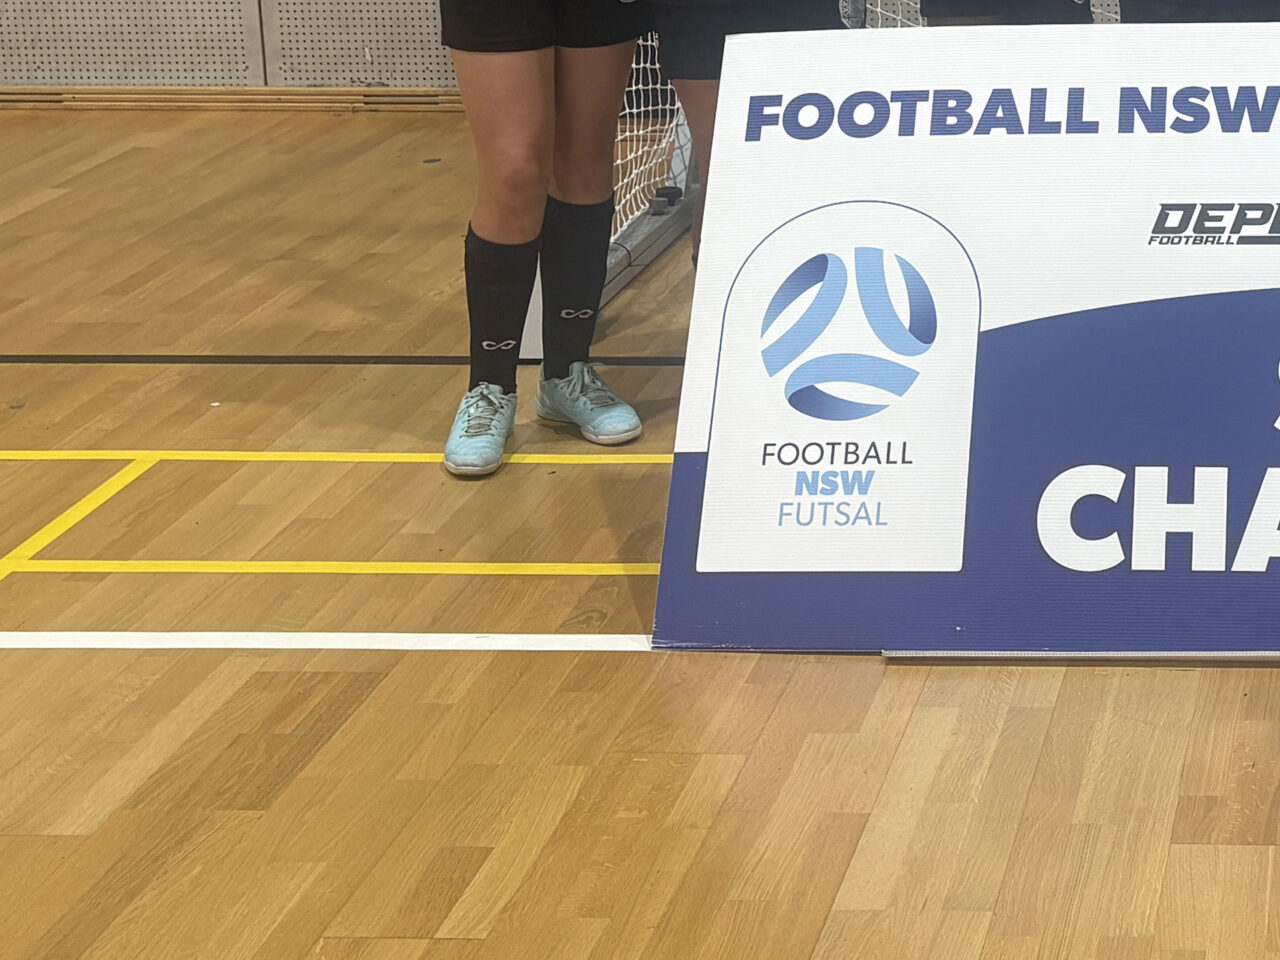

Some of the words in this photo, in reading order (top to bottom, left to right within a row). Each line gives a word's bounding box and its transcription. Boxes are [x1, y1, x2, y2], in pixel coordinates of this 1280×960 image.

[745, 88, 1100, 141] FOOTBALL
[1148, 235, 1235, 245] FOOTBALL
[762, 441, 913, 466] FOOTBALL
[794, 470, 876, 496] NSW
[778, 501, 888, 527] FUTSAL
